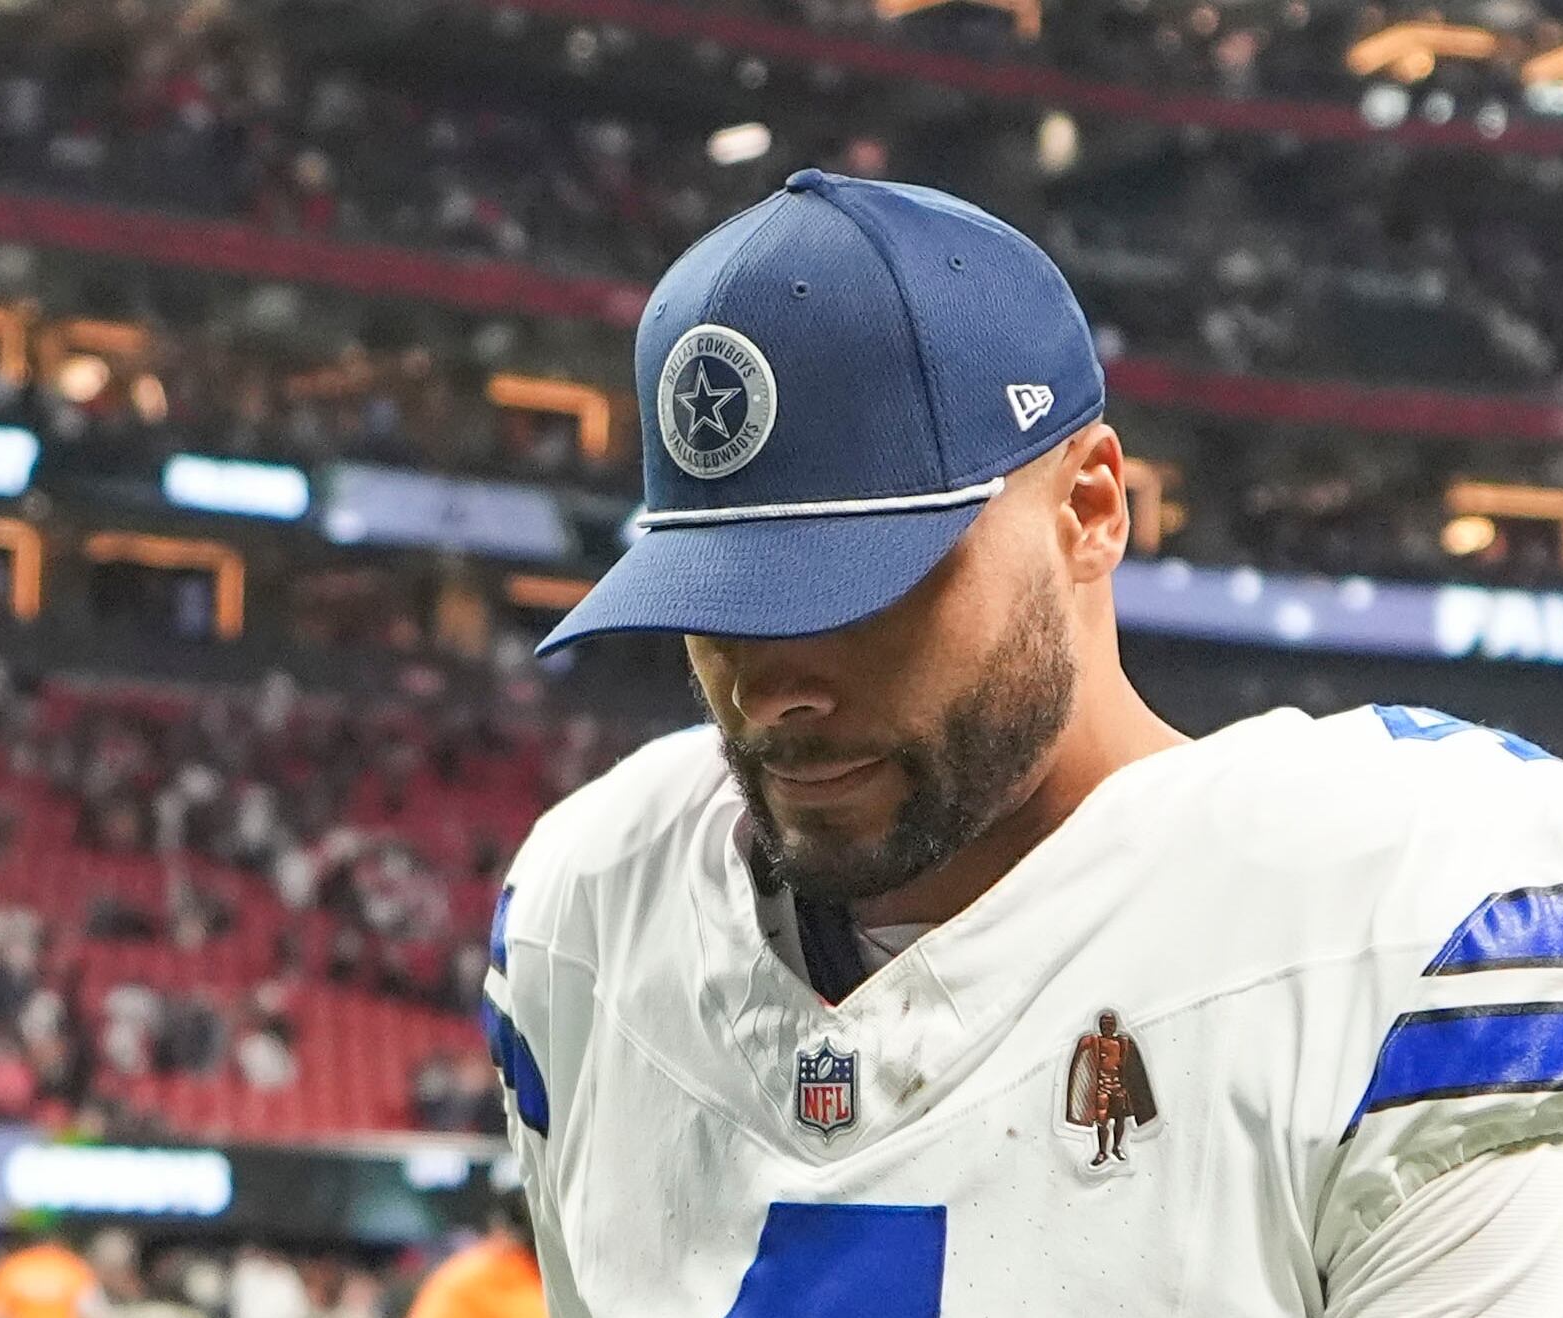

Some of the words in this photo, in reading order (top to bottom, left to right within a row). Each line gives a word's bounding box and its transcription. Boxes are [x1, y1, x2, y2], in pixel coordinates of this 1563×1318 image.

[667, 342, 695, 385] DALLAS
[696, 337, 757, 379] COWBOYS
[669, 429, 702, 468] DALLAS
[702, 421, 760, 469] COWBOYS
[804, 1086, 849, 1125] NFL
